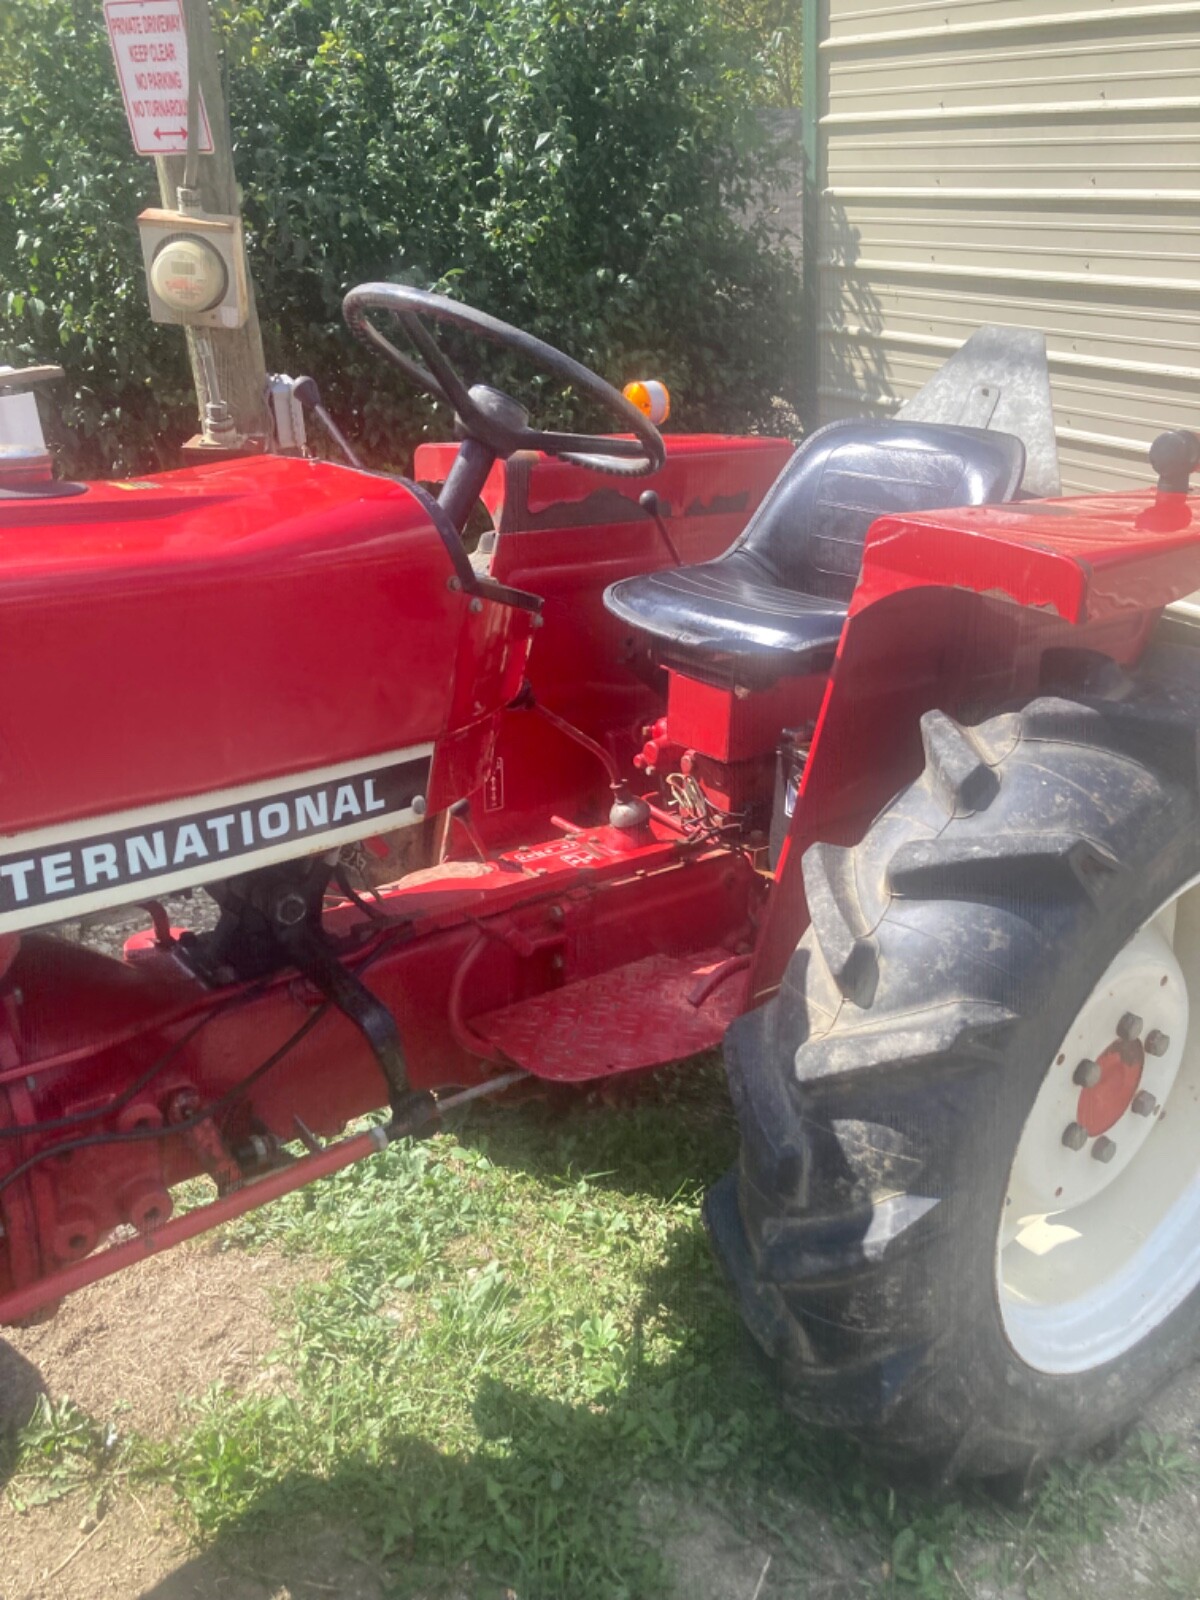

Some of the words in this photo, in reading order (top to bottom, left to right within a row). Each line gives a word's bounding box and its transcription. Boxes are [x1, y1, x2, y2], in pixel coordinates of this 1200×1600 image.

[110, 15, 143, 35] PRIVATE
[142, 14, 181, 33] DRIVEWAY
[128, 44, 148, 63] KEEP
[149, 42, 177, 62] CLEAR
[135, 73, 148, 90] NO
[147, 71, 182, 90] PARKING
[132, 100, 145, 118] NO
[143, 99, 188, 117] TURNAROU
[0, 778, 385, 902] TERNATIONAL
